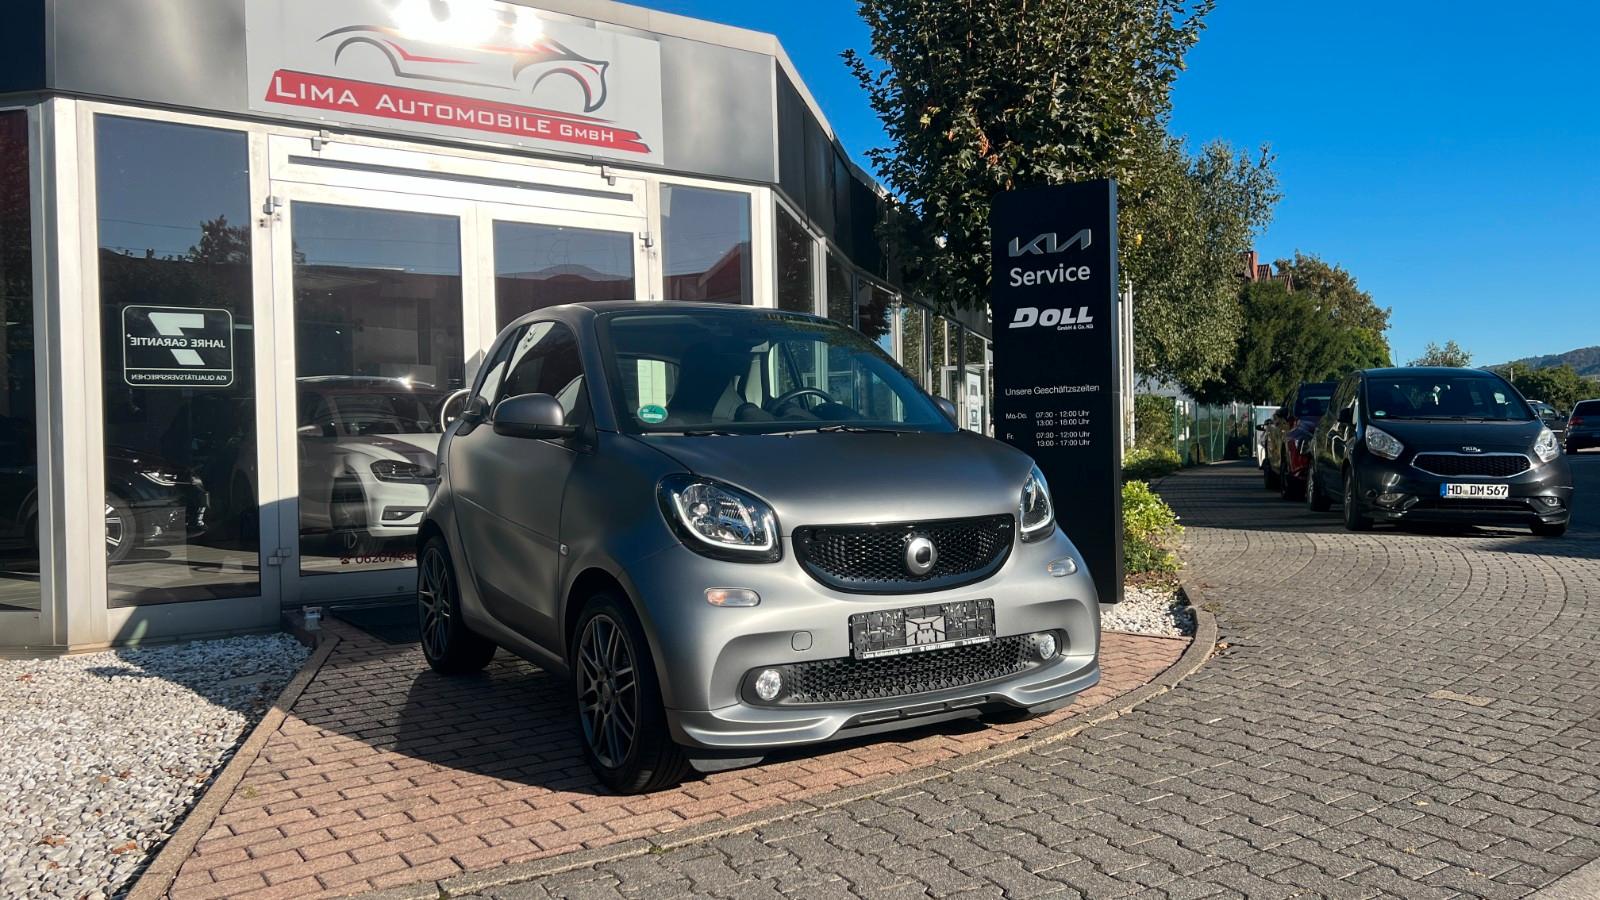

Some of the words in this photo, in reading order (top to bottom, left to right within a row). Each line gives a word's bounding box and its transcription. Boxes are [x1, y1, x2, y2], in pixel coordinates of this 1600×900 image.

[275, 76, 360, 108] LIMA
[375, 93, 551, 134] AUTOMOBILE
[1009, 263, 1091, 287] Service
[1005, 388, 1032, 396] Unsere
[1035, 411, 1054, 419] 07:30
[1060, 410, 1077, 418] 12:00
[1078, 409, 1089, 417] Uhr
[1035, 431, 1054, 439] 07:30
[1078, 430, 1090, 438] Uhr
[1060, 439, 1078, 447] 17:00
[1447, 485, 1463, 495] HD
[1469, 485, 1485, 496] DM
[1486, 485, 1508, 496] 567
